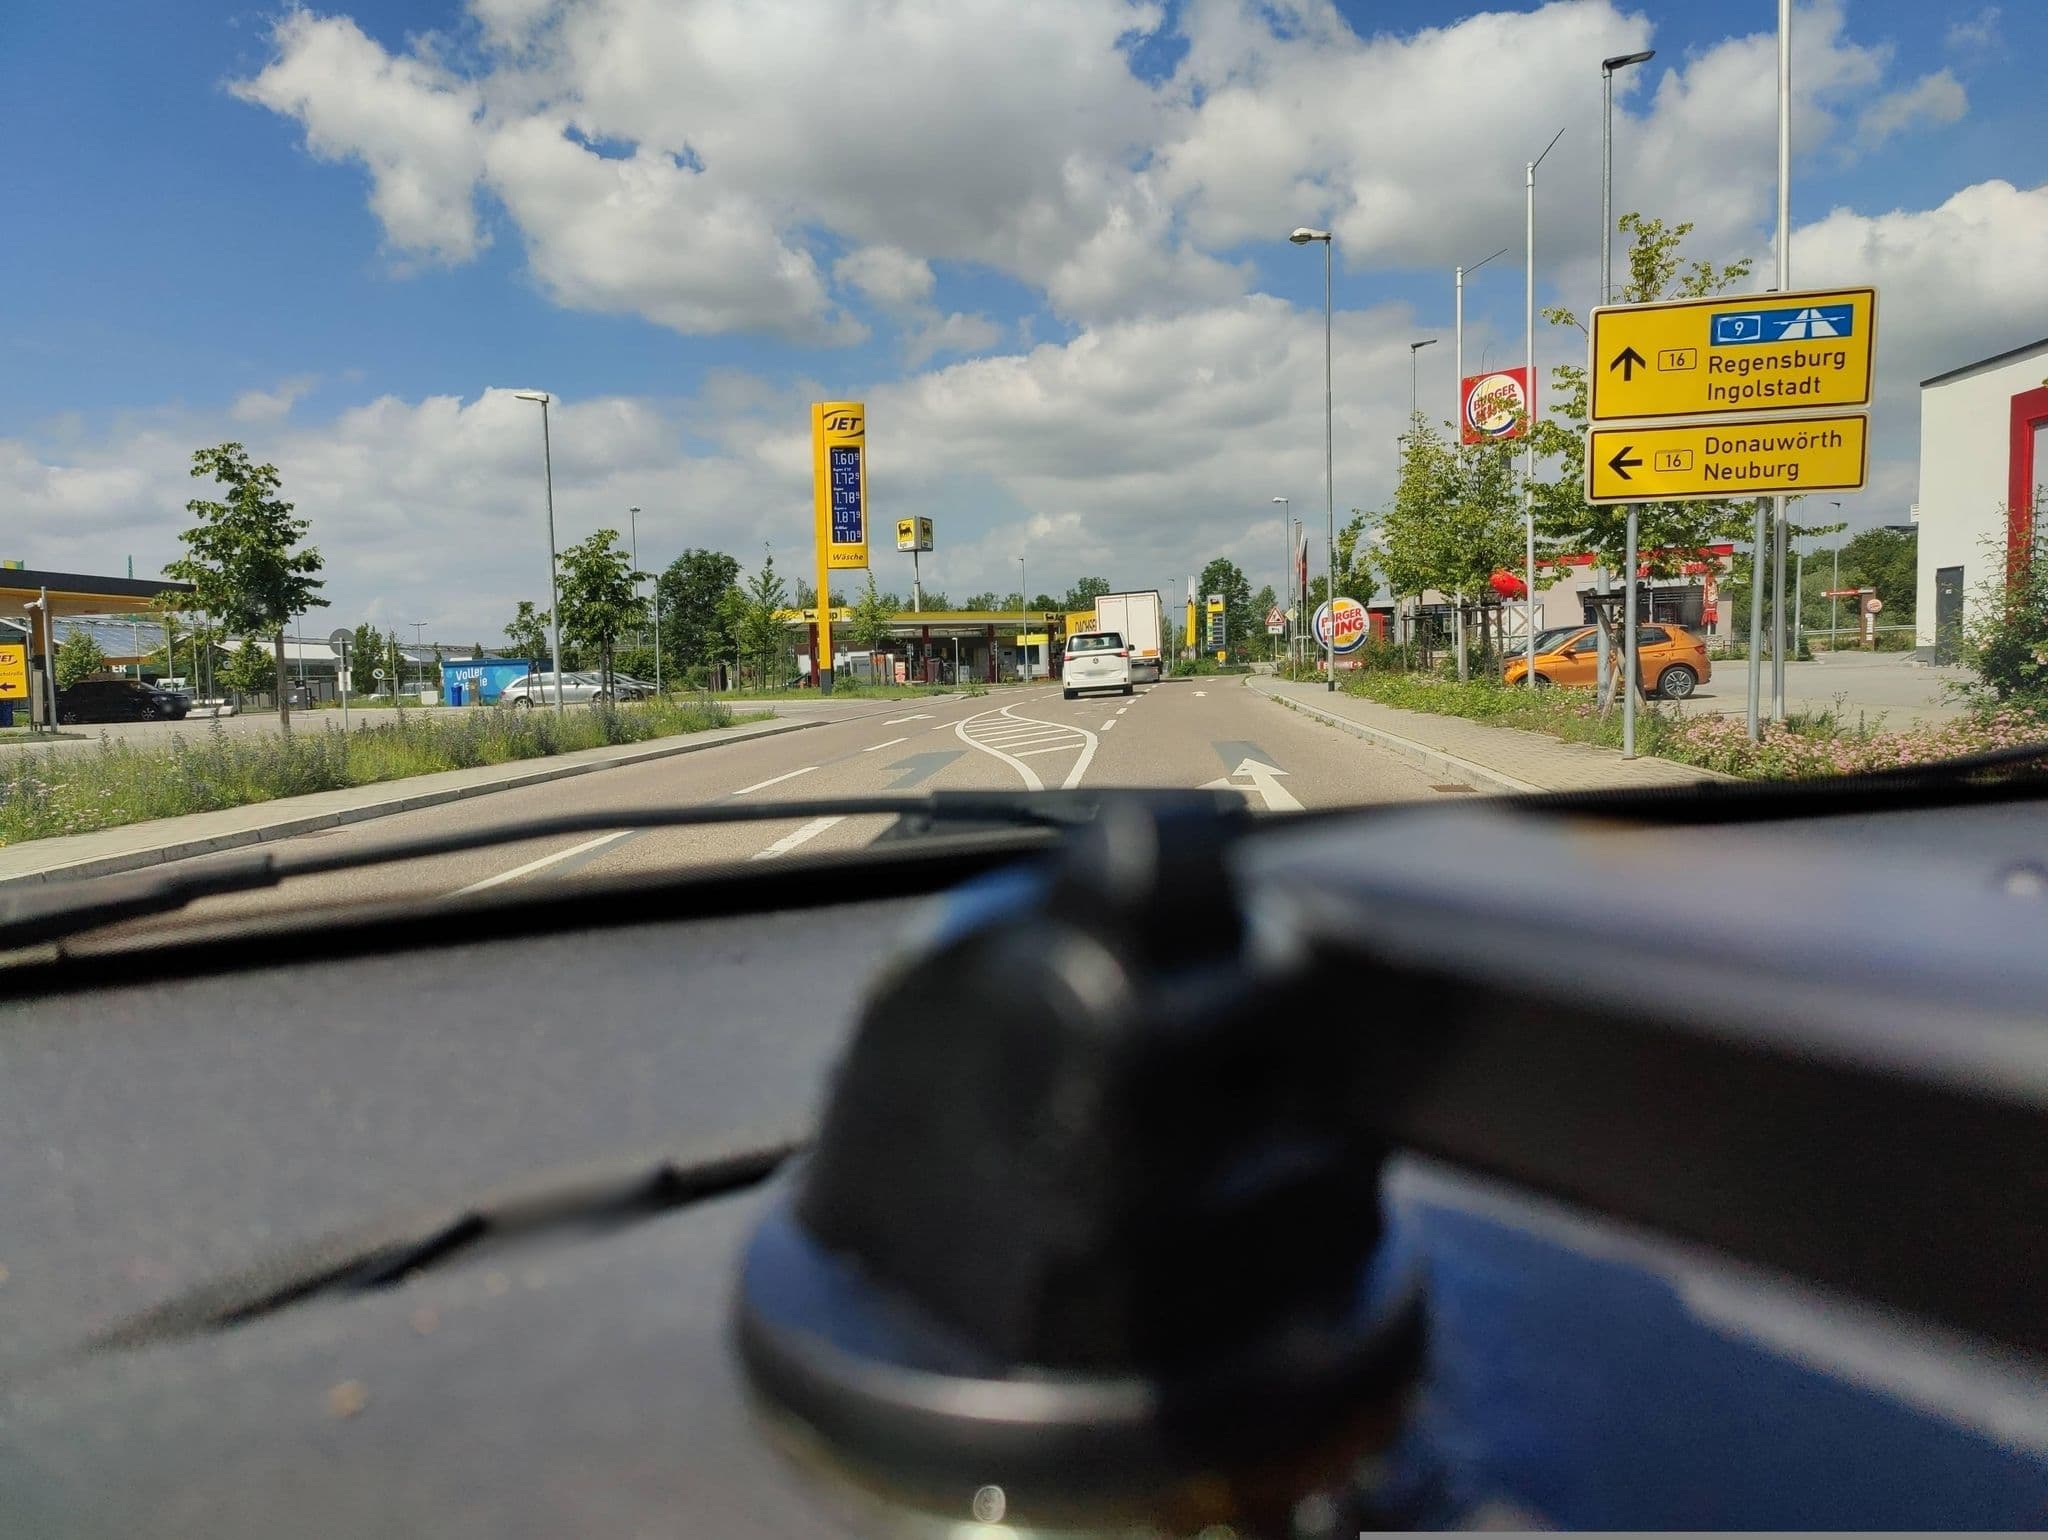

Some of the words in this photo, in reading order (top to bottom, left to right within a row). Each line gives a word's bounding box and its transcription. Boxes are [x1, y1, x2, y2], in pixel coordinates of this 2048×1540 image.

[1733, 321, 1744, 336] 9
[1669, 352, 1686, 367] 16
[1708, 350, 1846, 376] Regensburg
[1708, 376, 1821, 403] Ingolstadt
[827, 417, 862, 431] JET
[1705, 430, 1842, 455] Donauwörth
[1666, 453, 1682, 468] 16
[1704, 460, 1800, 481] Neuburg
[832, 552, 864, 561] Wäsche
[456, 667, 483, 681] Voller
